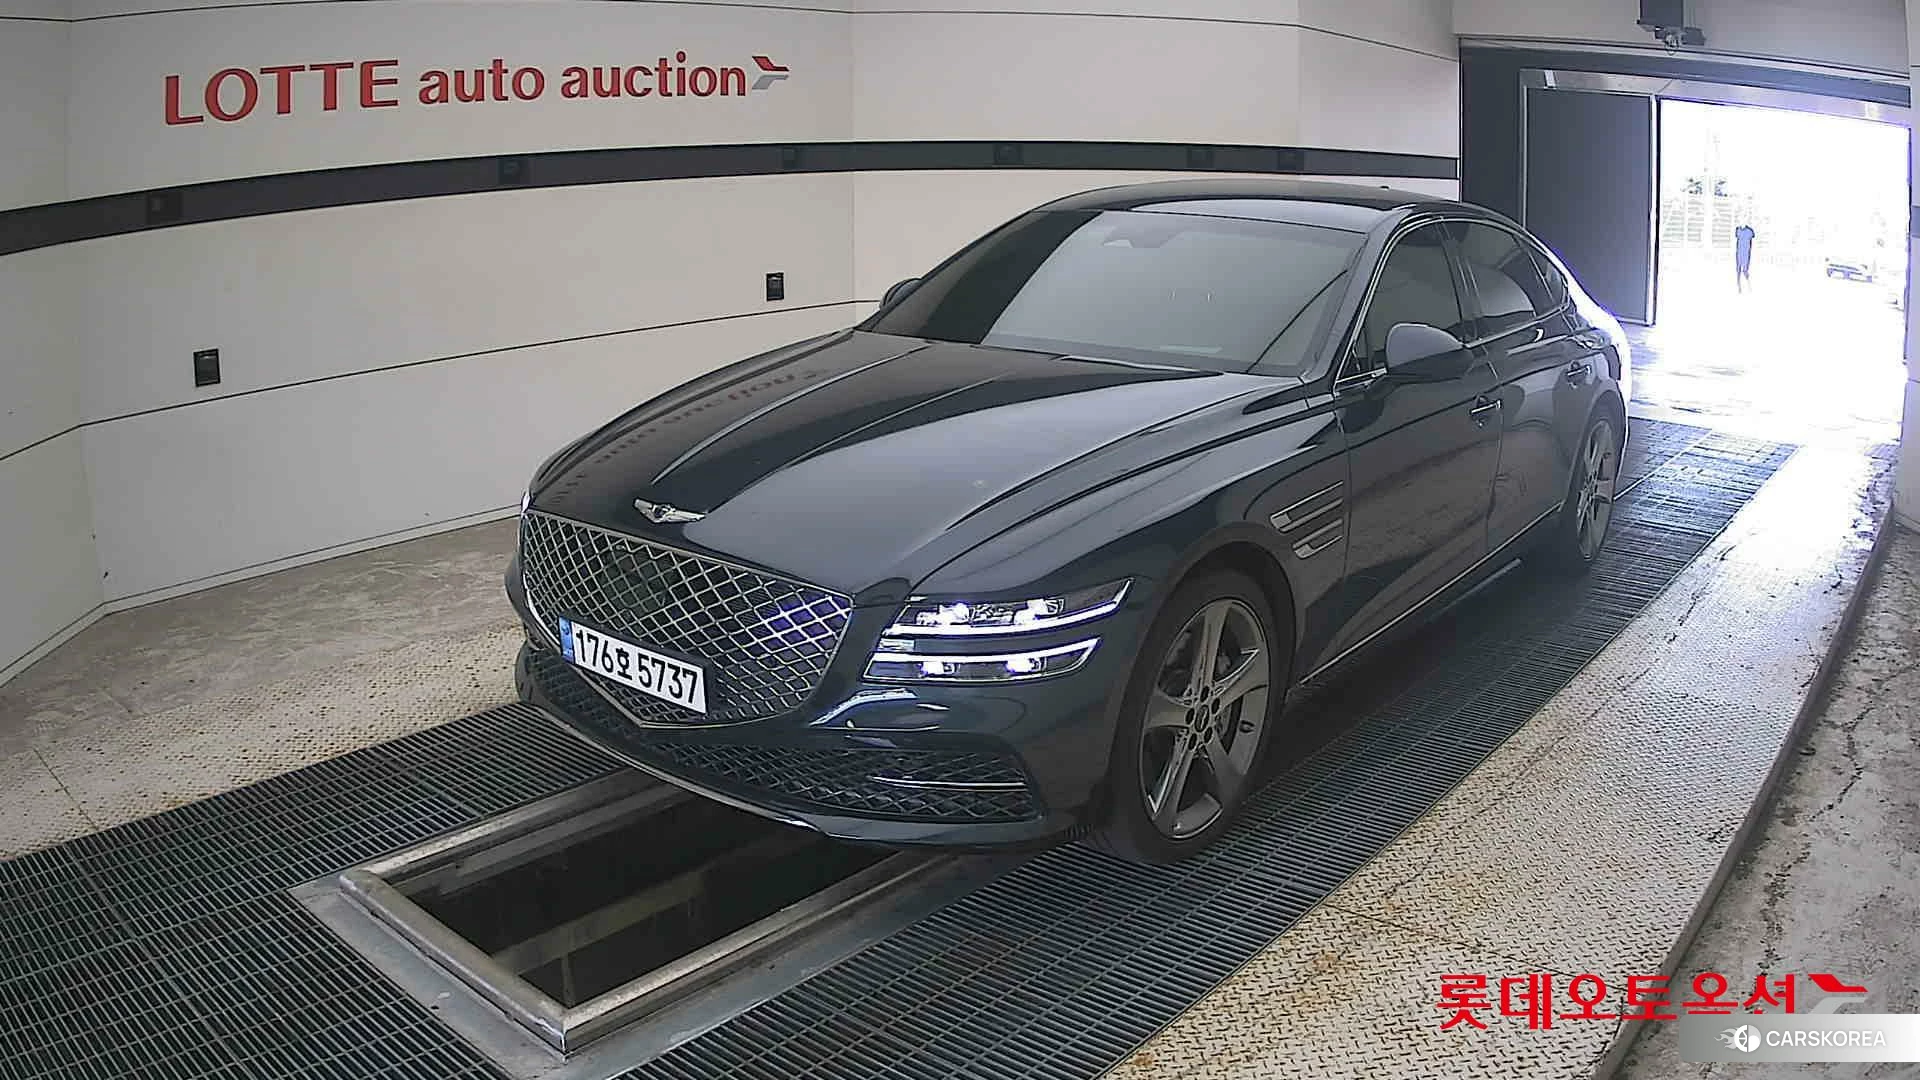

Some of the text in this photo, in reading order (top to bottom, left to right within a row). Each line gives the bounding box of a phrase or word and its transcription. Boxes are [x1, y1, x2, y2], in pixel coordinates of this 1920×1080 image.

[164, 51, 748, 125] LOTTE auto auction
[575, 629, 698, 704] 176호 5737
